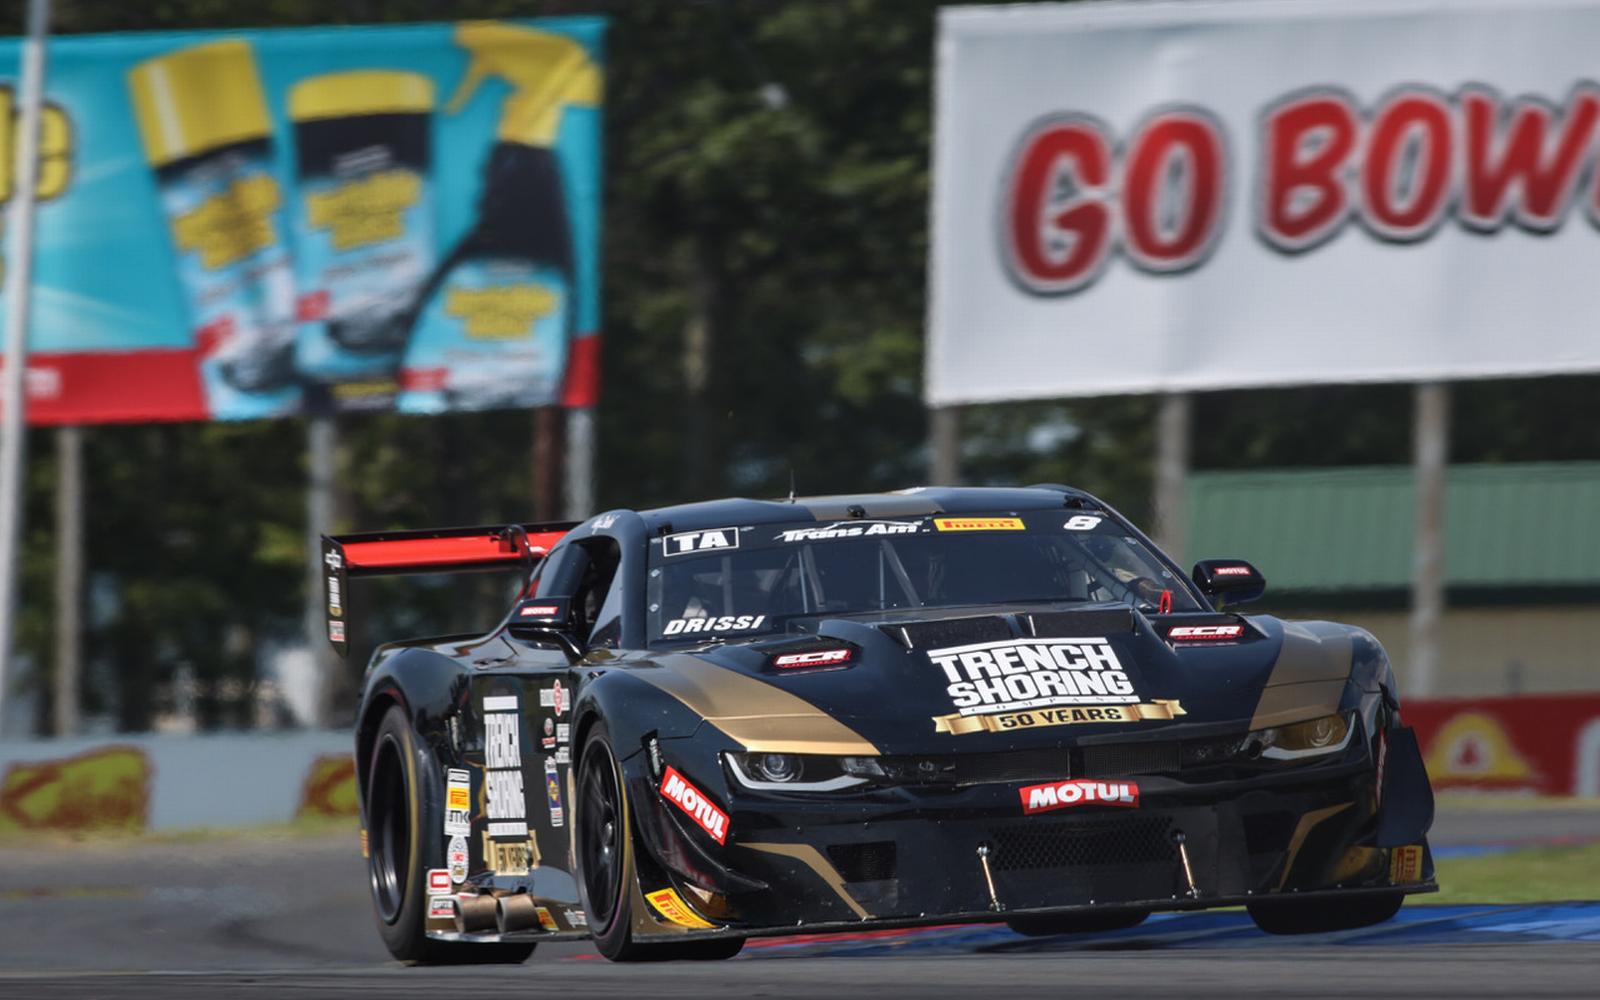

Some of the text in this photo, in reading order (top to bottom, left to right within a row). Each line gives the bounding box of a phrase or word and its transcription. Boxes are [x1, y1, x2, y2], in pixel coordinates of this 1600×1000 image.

[1006, 85, 1600, 288] GO BOW
[783, 523, 917, 542] Trans Am
[942, 518, 1016, 529] PIRELLI
[1063, 515, 1102, 530] 8
[673, 531, 729, 552] TA
[663, 615, 765, 635] DRISSI
[1170, 625, 1241, 637] ECR
[776, 650, 848, 664] ECR
[931, 644, 1123, 684] TRENCH
[946, 670, 1135, 707] SHORING
[1000, 708, 1122, 728] 50 YEARS
[1029, 783, 1135, 809] MOTUL
[663, 774, 724, 839] MOTUL
